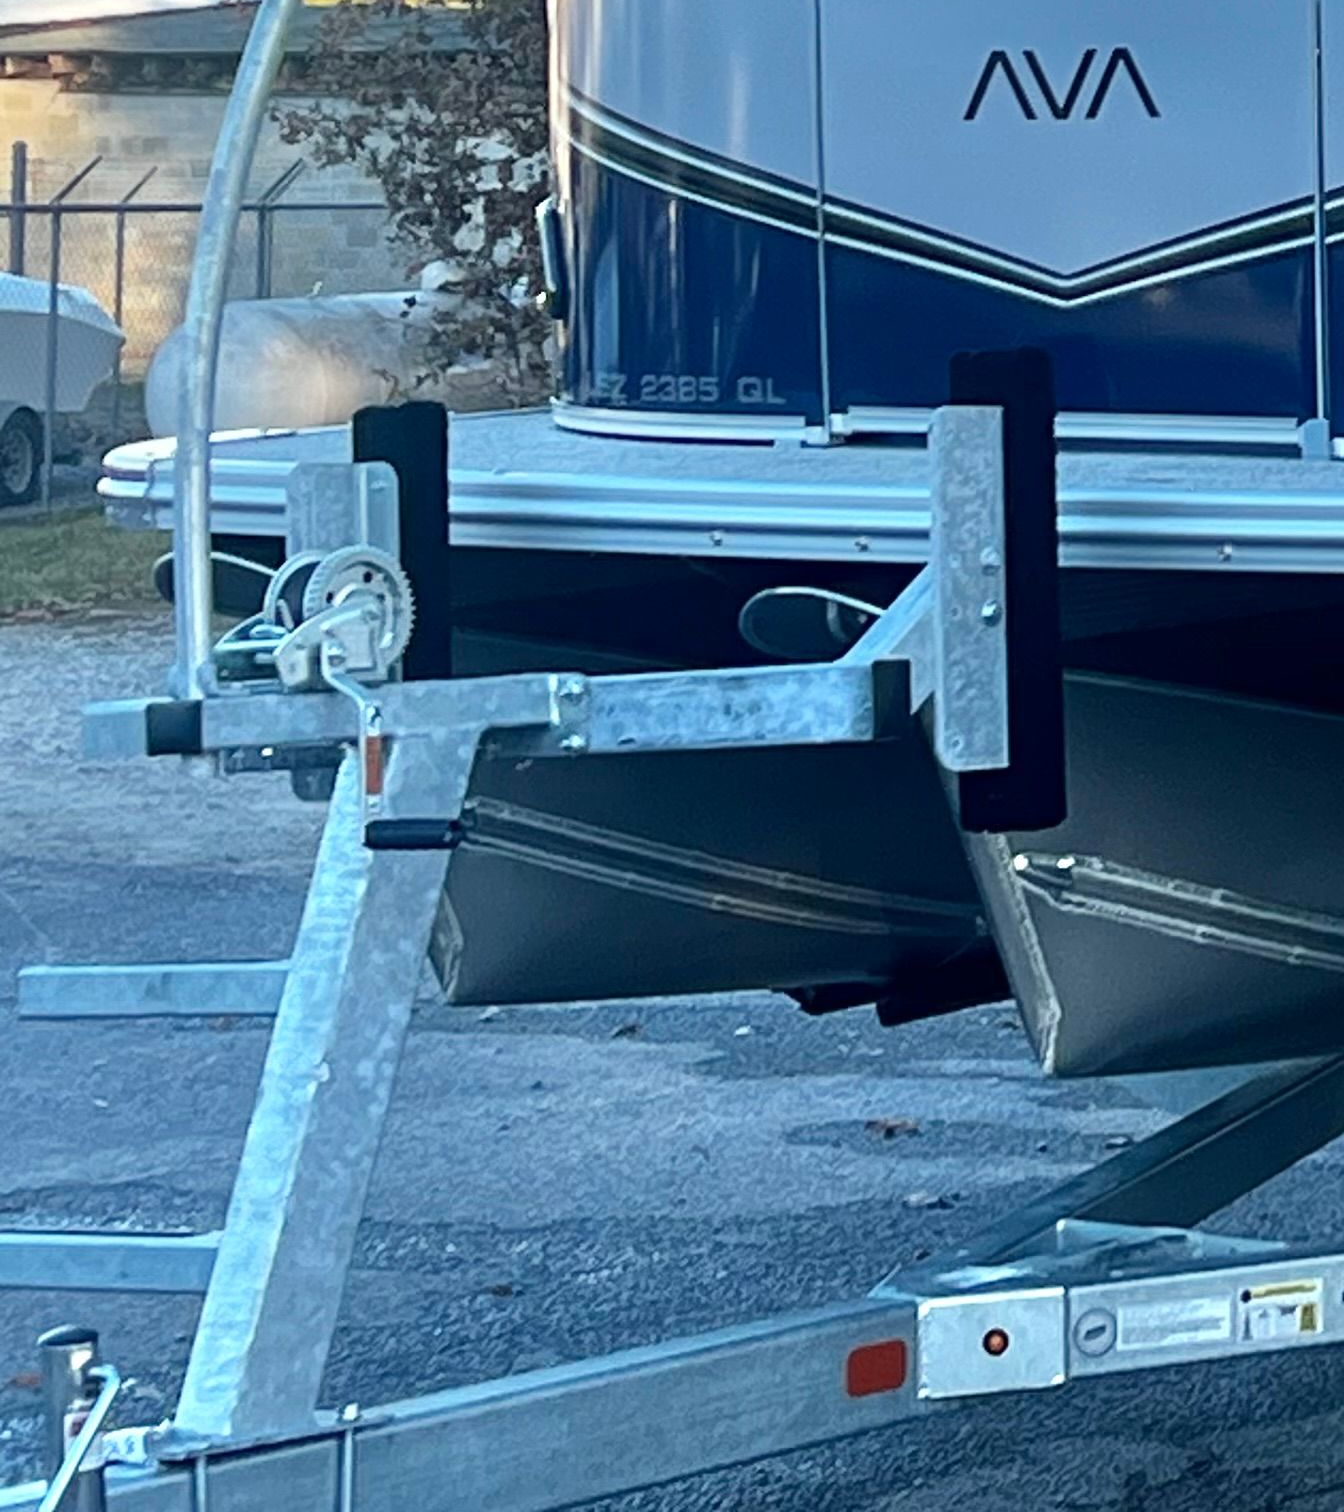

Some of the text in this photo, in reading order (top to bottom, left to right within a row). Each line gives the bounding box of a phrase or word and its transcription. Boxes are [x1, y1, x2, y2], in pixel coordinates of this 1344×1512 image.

[963, 47, 1161, 120] AVA
[640, 374, 719, 402] 2385
[737, 375, 786, 404] QL
